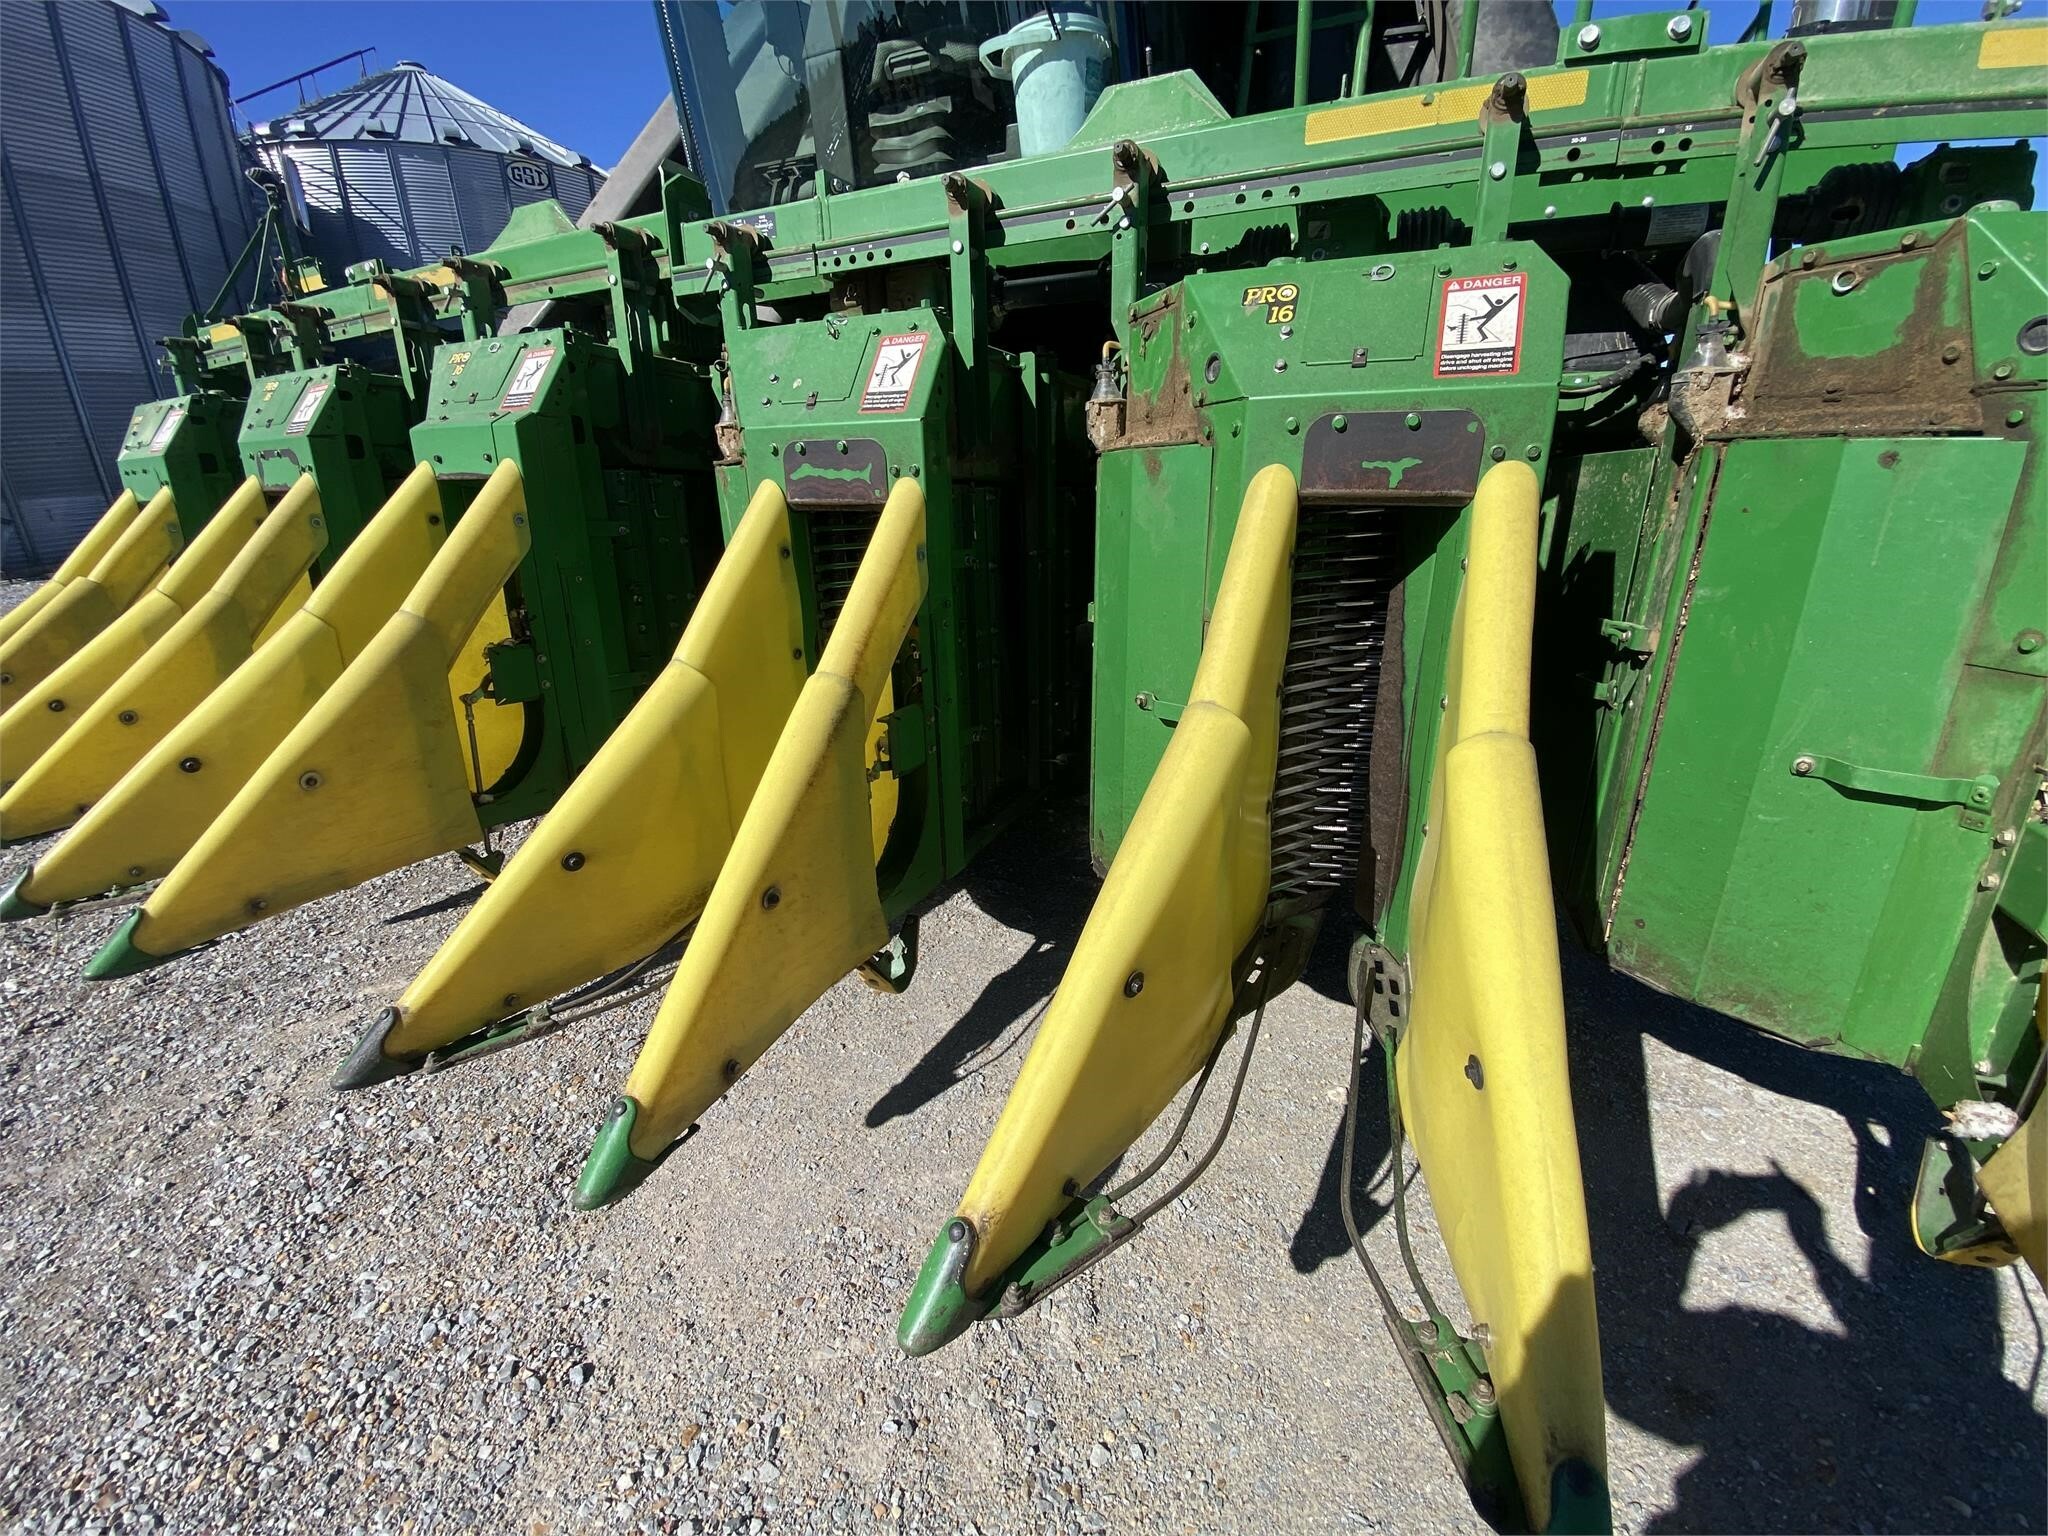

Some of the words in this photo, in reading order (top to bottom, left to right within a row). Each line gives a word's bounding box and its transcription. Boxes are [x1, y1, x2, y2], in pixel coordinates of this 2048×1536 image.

[511, 166, 545, 187] GSI
[1463, 275, 1522, 290] DANGER
[1243, 284, 1298, 305] PRO
[1268, 304, 1294, 323] 16
[891, 334, 926, 345] DANGER
[1471, 351, 1501, 359] harvesting
